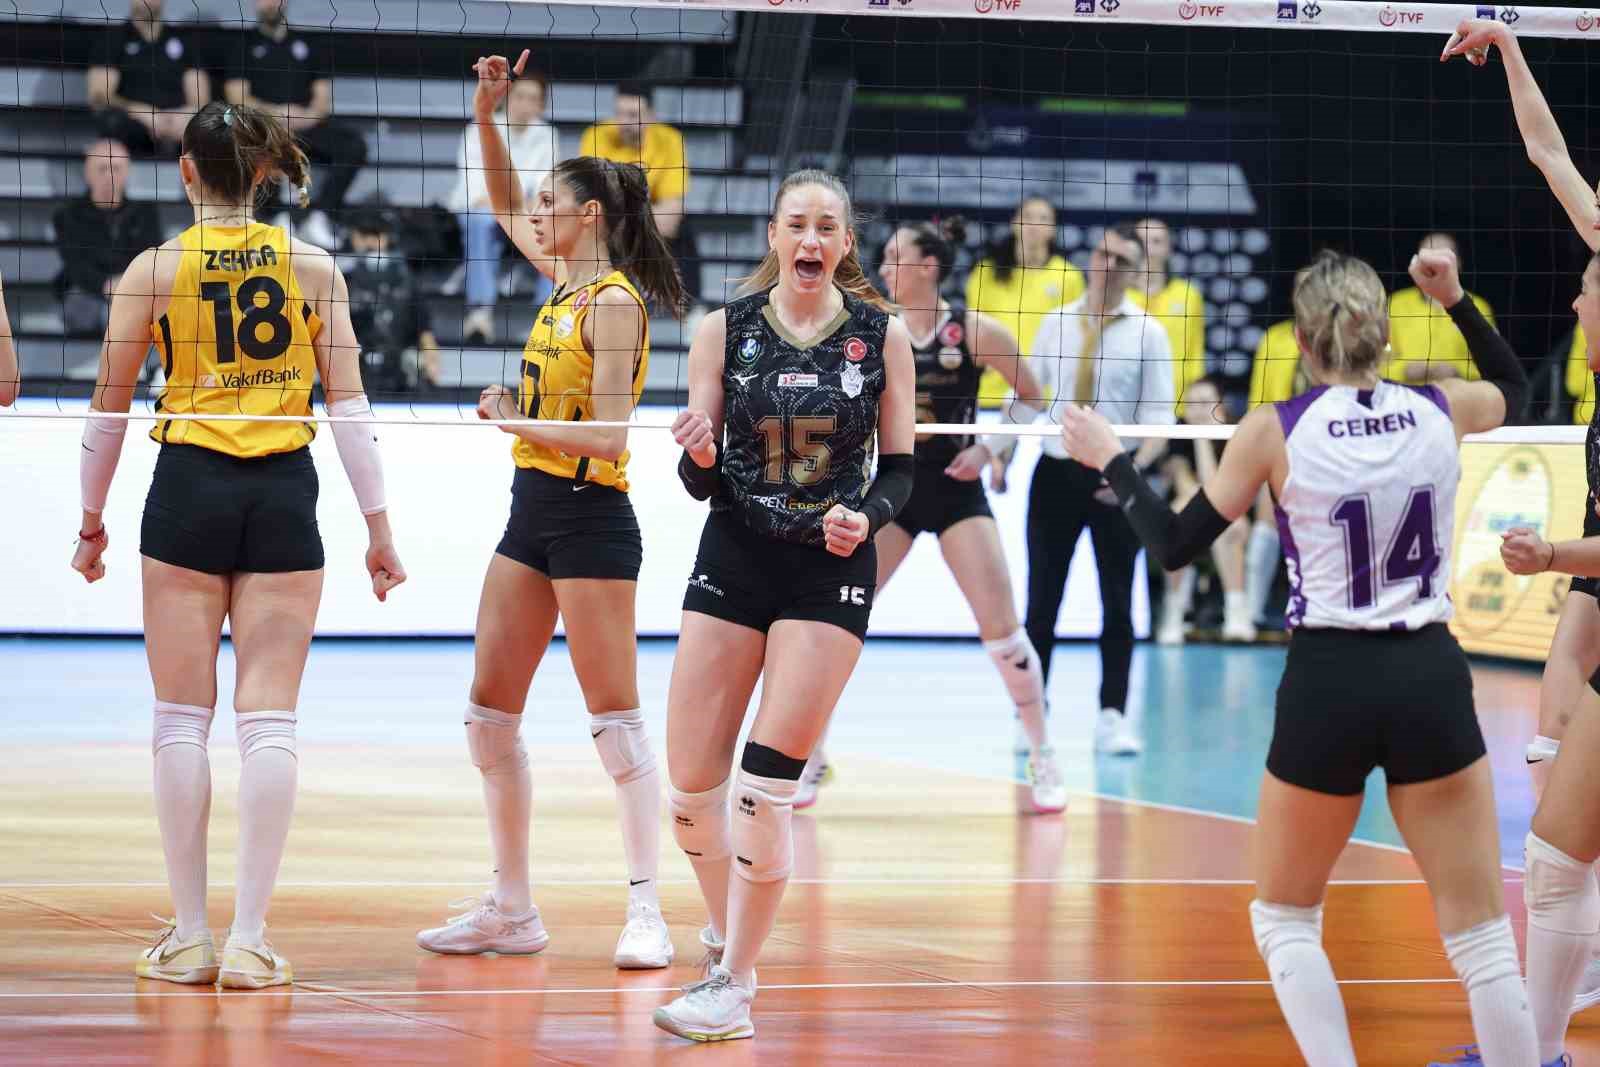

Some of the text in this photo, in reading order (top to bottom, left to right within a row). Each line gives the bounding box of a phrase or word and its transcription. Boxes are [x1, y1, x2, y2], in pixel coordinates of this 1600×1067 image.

[1200, 6, 1225, 17] TVF
[1399, 12, 1424, 24] TVF
[200, 276, 293, 363] 18
[1327, 410, 1417, 438] CEREN
[755, 415, 837, 487] 15
[747, 494, 786, 510] EREN
[1329, 484, 1444, 611] 14
